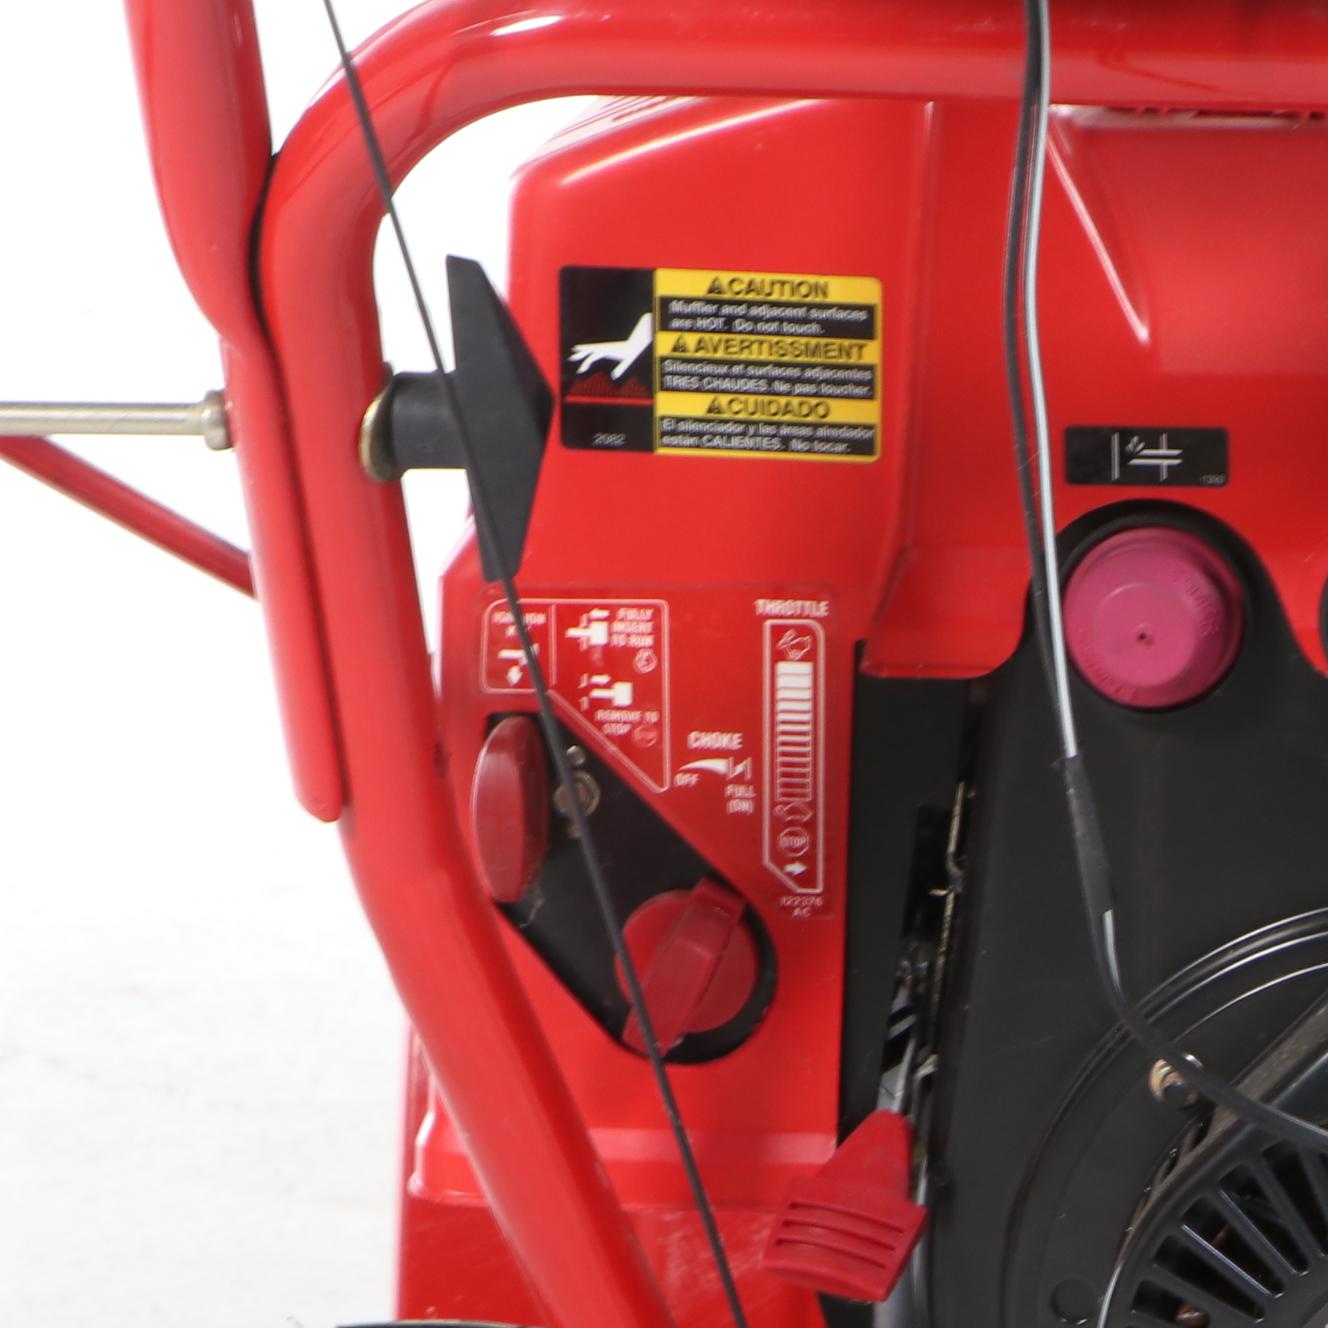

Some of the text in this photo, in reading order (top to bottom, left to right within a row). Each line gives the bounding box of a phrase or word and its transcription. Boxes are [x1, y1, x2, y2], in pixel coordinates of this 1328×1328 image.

[727, 277, 828, 299] CAUTION
[669, 300, 868, 321] Muffler and adjacent surfaces
[670, 317, 825, 335] are HOT. Do not touch.
[664, 360, 872, 381] Silencieux et surfaces adjacentes
[773, 380, 792, 392] Ne
[795, 383, 817, 396] pas
[727, 396, 830, 419] CUIDADO
[662, 418, 674, 430] El
[678, 419, 746, 434] silenciador
[759, 423, 777, 434] las
[790, 438, 809, 450] No
[753, 599, 829, 617] THROTTLE
[687, 731, 743, 750] CHOKE
[673, 773, 700, 787] OFF
[724, 784, 756, 798] FULL
[781, 836, 807, 848] STOP
